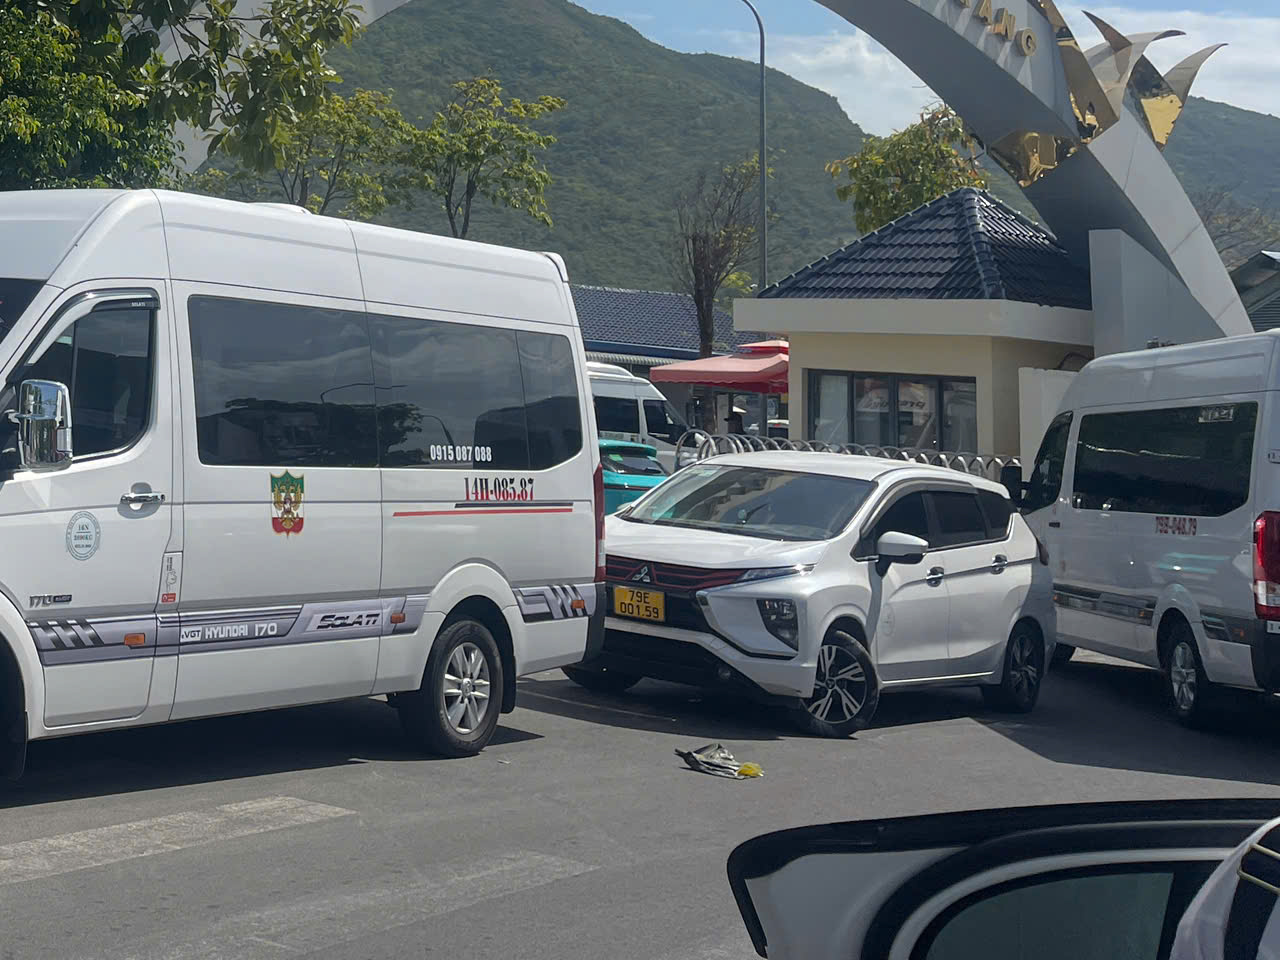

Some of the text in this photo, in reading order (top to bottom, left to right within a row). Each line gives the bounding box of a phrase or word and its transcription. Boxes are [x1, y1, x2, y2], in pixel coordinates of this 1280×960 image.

[429, 444, 492, 462] 0915 087 088
[464, 477, 535, 501] 14H-085.87
[629, 590, 650, 604] 79E
[620, 602, 659, 618] 001.59
[205, 623, 249, 639] HYUNDAI
[254, 622, 278, 637] 170
